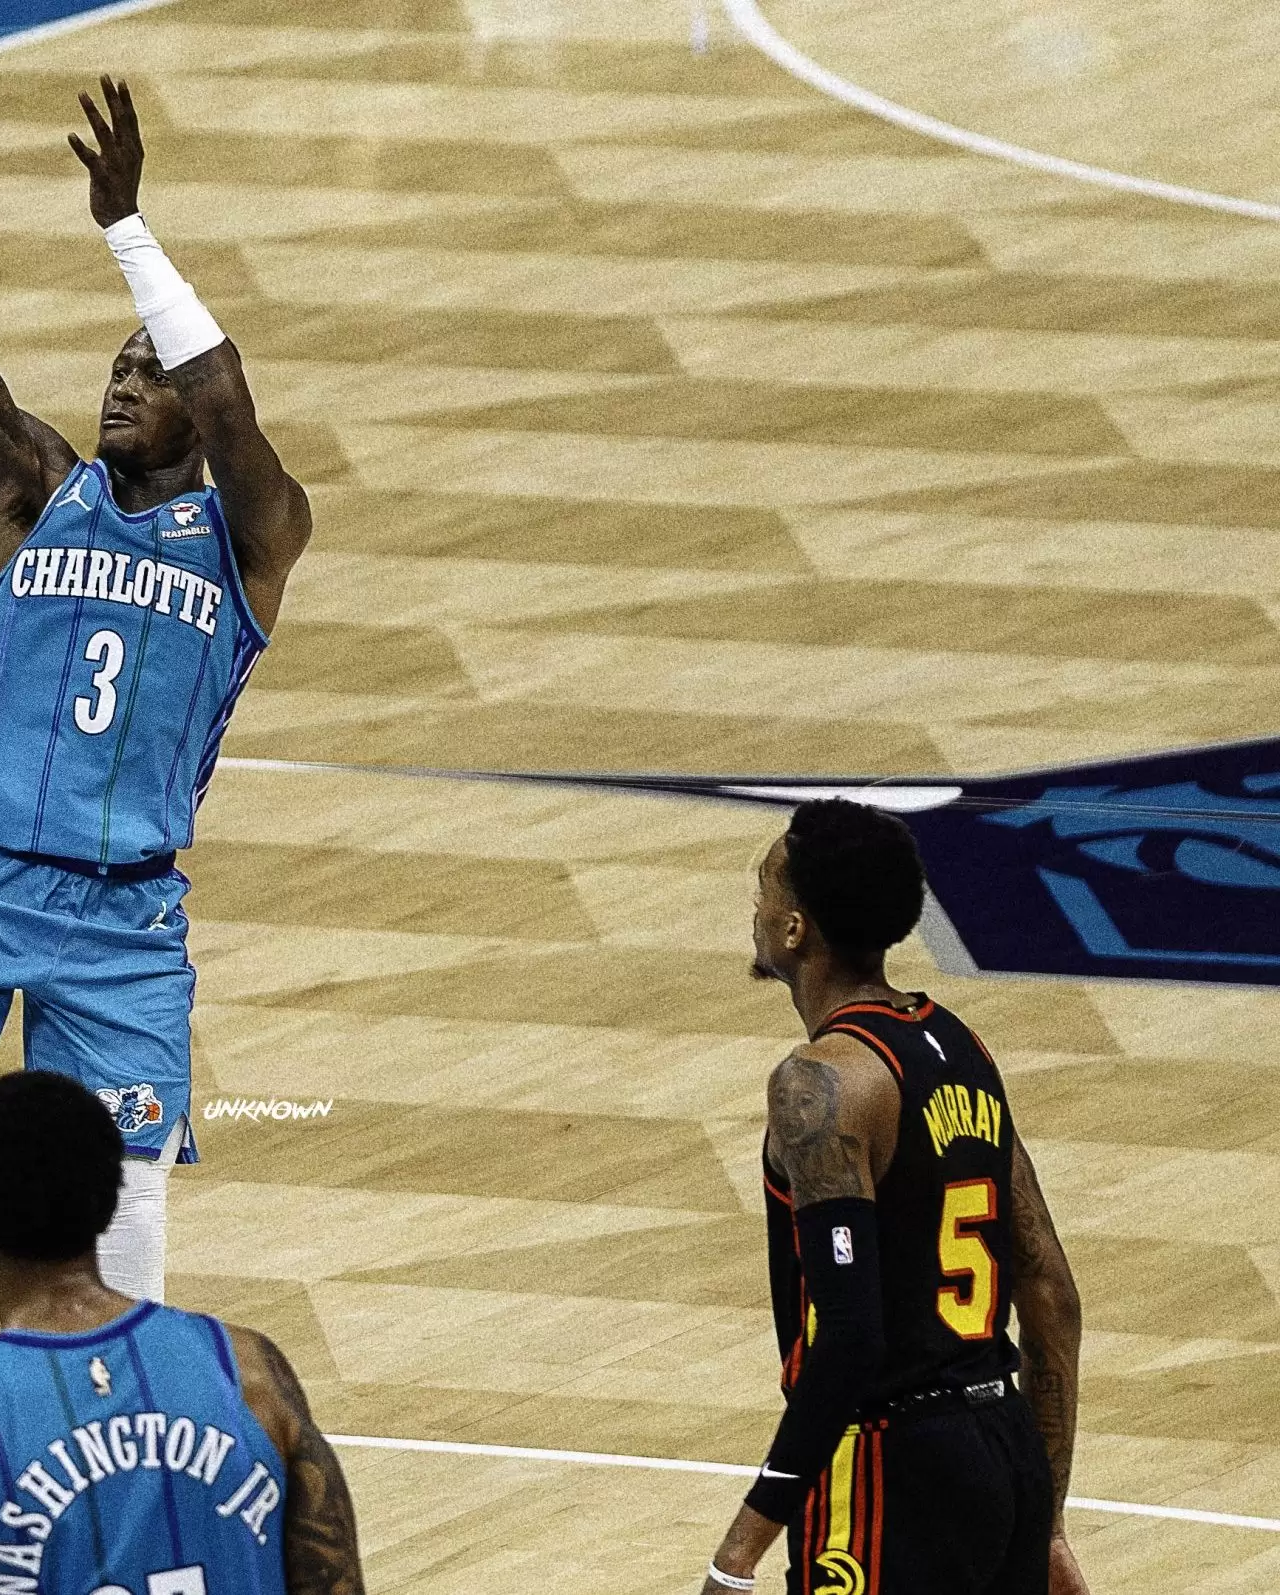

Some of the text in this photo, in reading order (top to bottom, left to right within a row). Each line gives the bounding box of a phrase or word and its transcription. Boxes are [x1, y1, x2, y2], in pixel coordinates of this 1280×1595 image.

[11, 547, 223, 636] CHARLOTTE
[73, 629, 125, 735] 3
[922, 1084, 1001, 1156] MURRAY
[937, 1177, 998, 1340] 5
[215, 1461, 281, 1547] JR.
